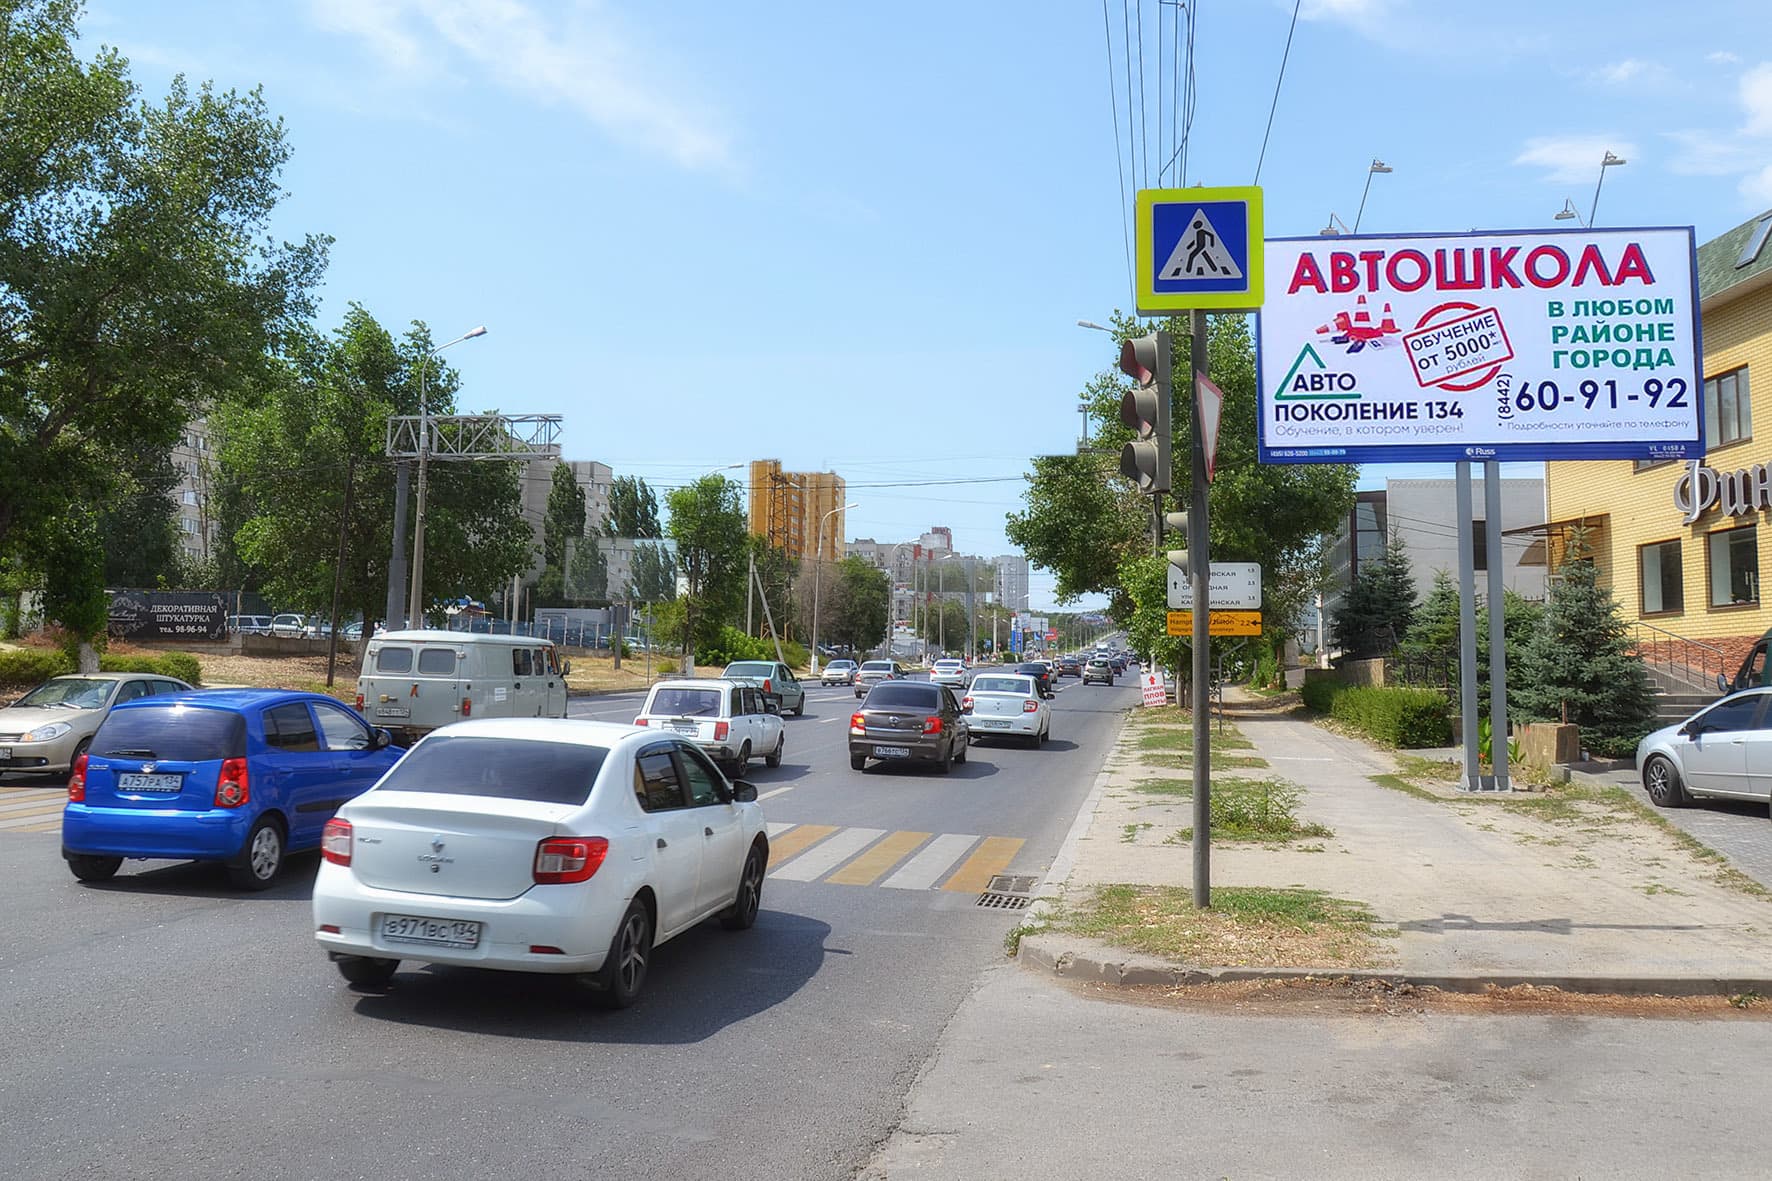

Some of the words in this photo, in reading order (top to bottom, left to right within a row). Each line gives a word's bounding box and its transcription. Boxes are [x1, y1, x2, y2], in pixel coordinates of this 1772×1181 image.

[1287, 243, 1657, 294] АВТОШКОЛА
[1548, 301, 1565, 317] В
[1572, 298, 1674, 317] ЛЮБОМ
[1410, 314, 1496, 351] ОБУЧЕНИЕ
[1551, 319, 1676, 344] РАЙОНЕ
[1445, 353, 1487, 374] рублей
[1553, 348, 1676, 371] ГОРОДА
[1292, 373, 1356, 392] АВТО
[1496, 373, 1514, 420] (8442)
[1515, 378, 1688, 411] 60-91-92
[1275, 402, 1418, 421] ПОКОЛЕНИЕ
[1424, 401, 1464, 420] 134
[1275, 425, 1342, 437] Обучение,
[1345, 426, 1353, 435] в
[1356, 425, 1410, 437] котором
[1413, 422, 1464, 436] уверен!
[1507, 421, 1574, 431] Подробности
[1577, 420, 1622, 430] уточняйте
[1624, 421, 1637, 429] по
[1639, 419, 1690, 429] телефону
[1475, 447, 1497, 456] Russ
[149, 604, 218, 613] ДЕКОРАТИВНАЯ
[156, 614, 210, 622] ШТУКАТУРКА
[175, 625, 208, 633] 98-96-94
